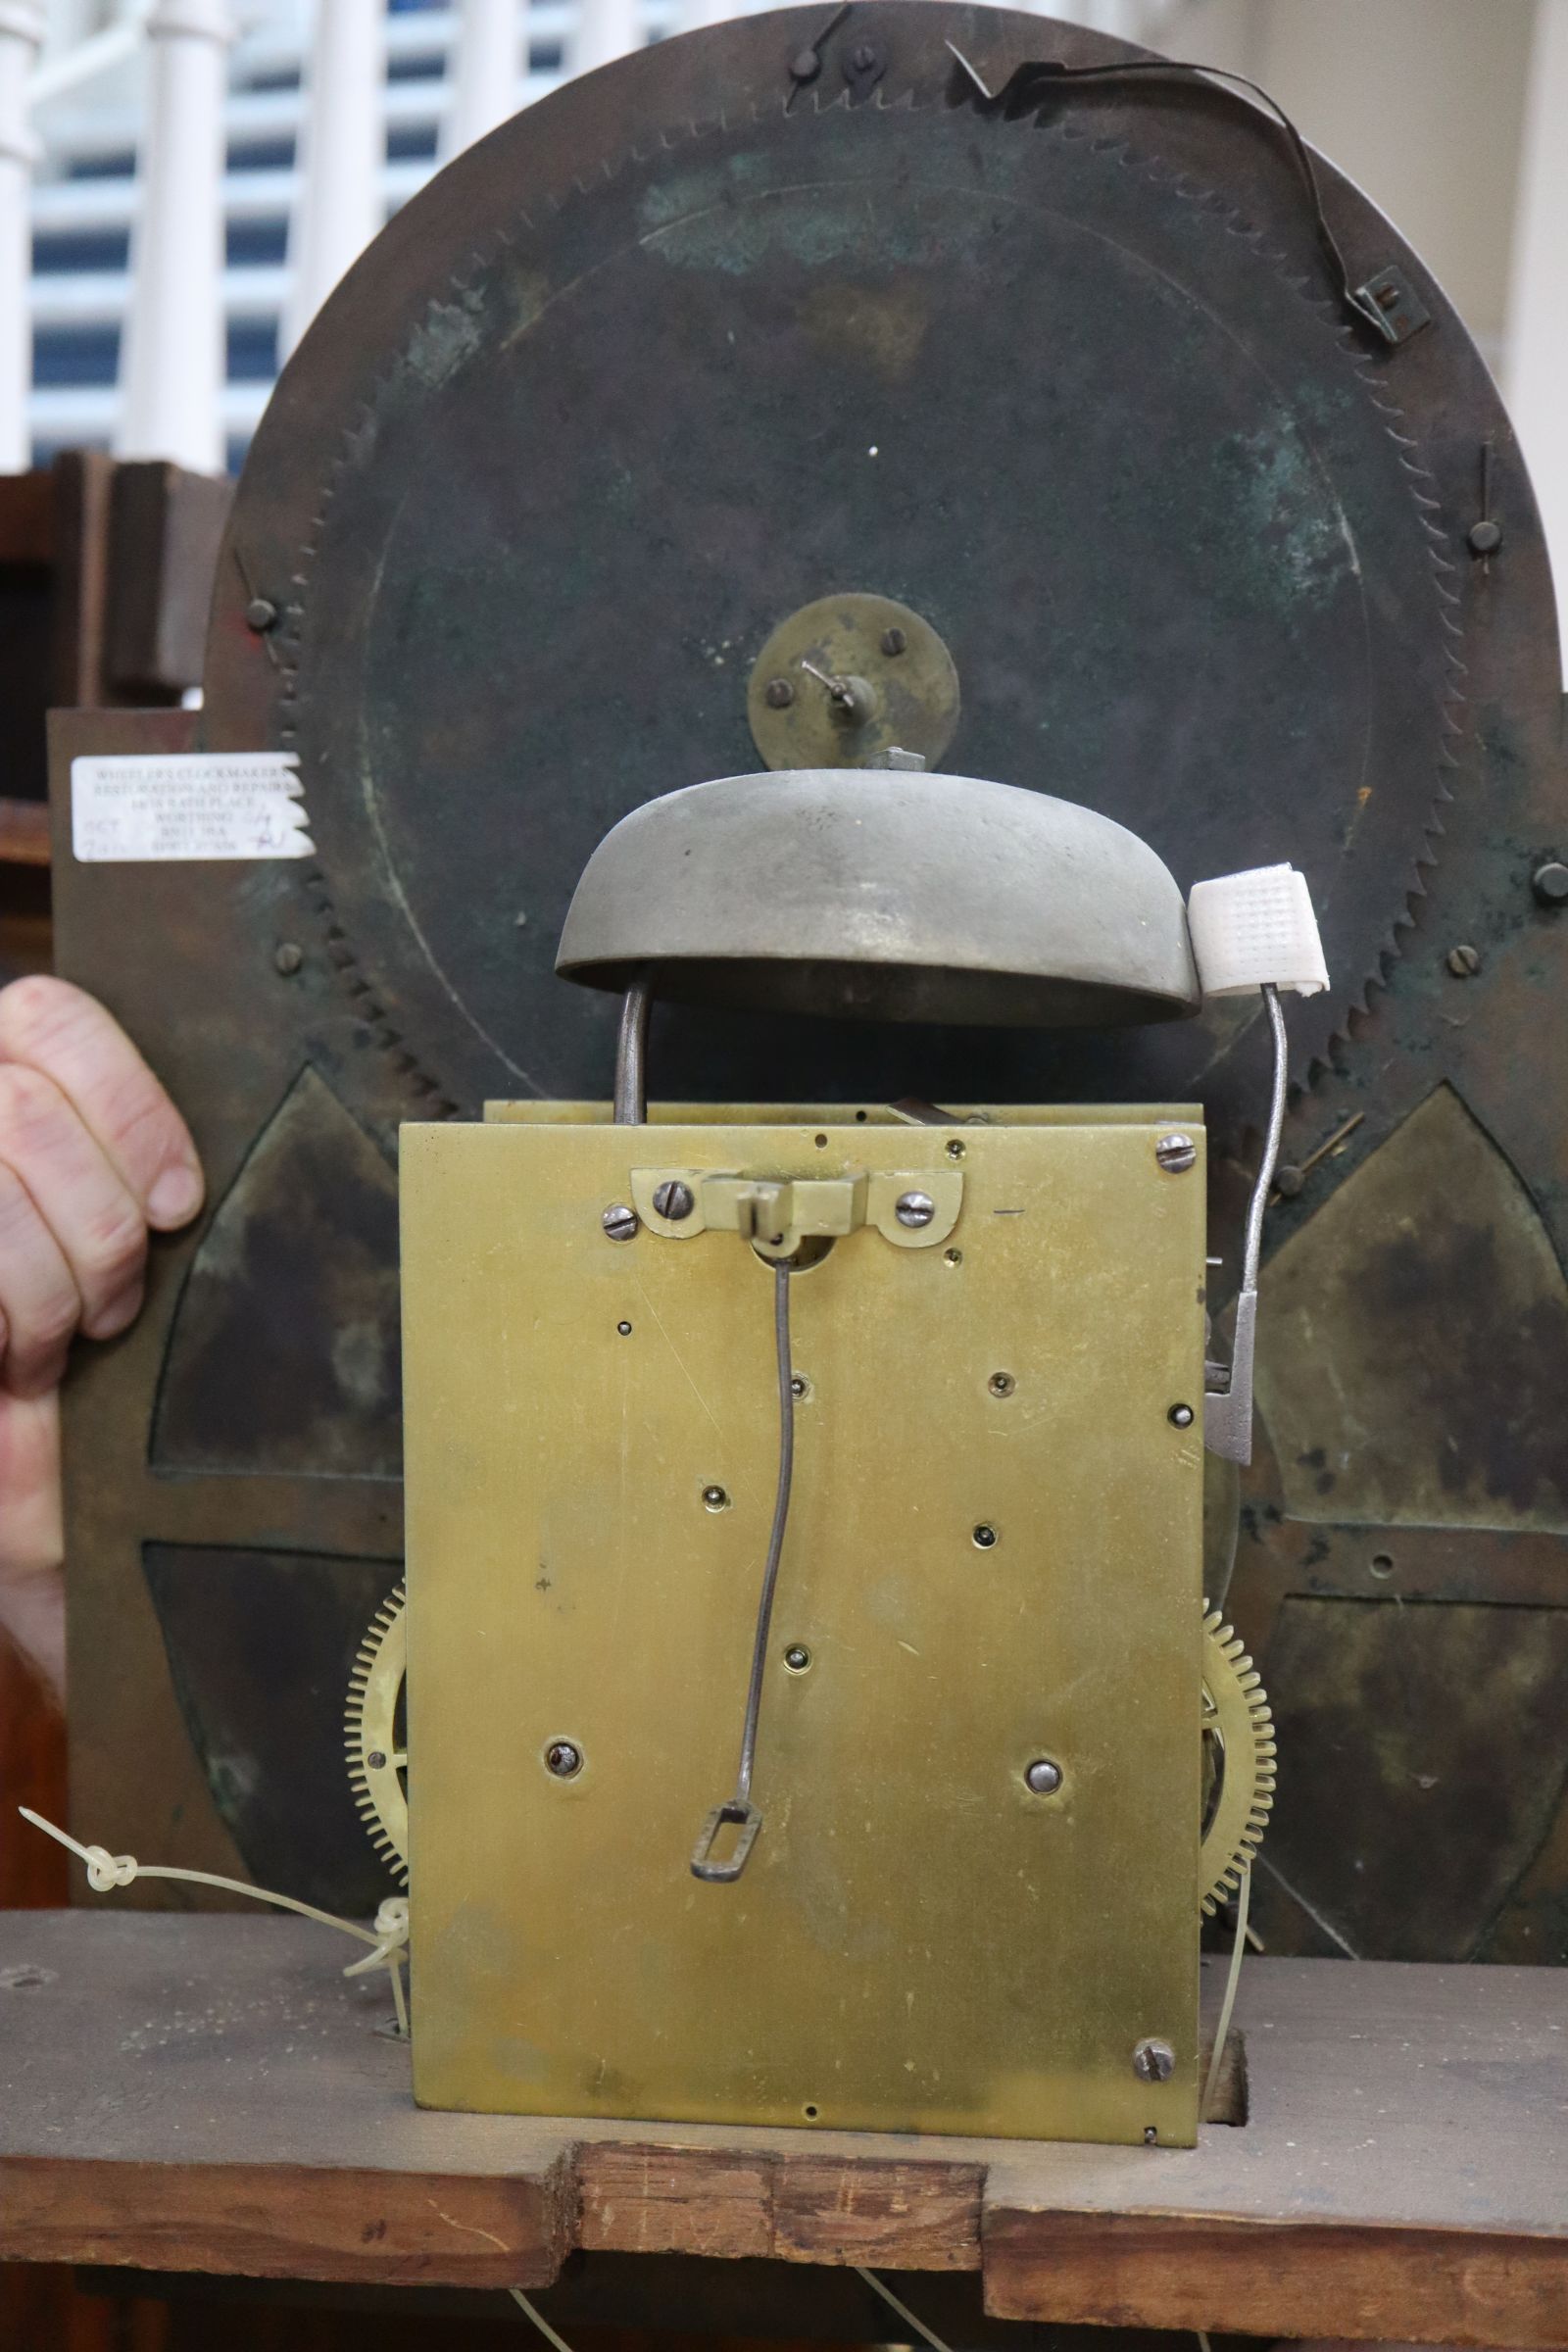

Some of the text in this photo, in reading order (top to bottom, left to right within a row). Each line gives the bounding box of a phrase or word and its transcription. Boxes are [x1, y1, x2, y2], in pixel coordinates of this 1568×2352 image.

[93, 782, 293, 797] RESTORATION AND REPAIRS
